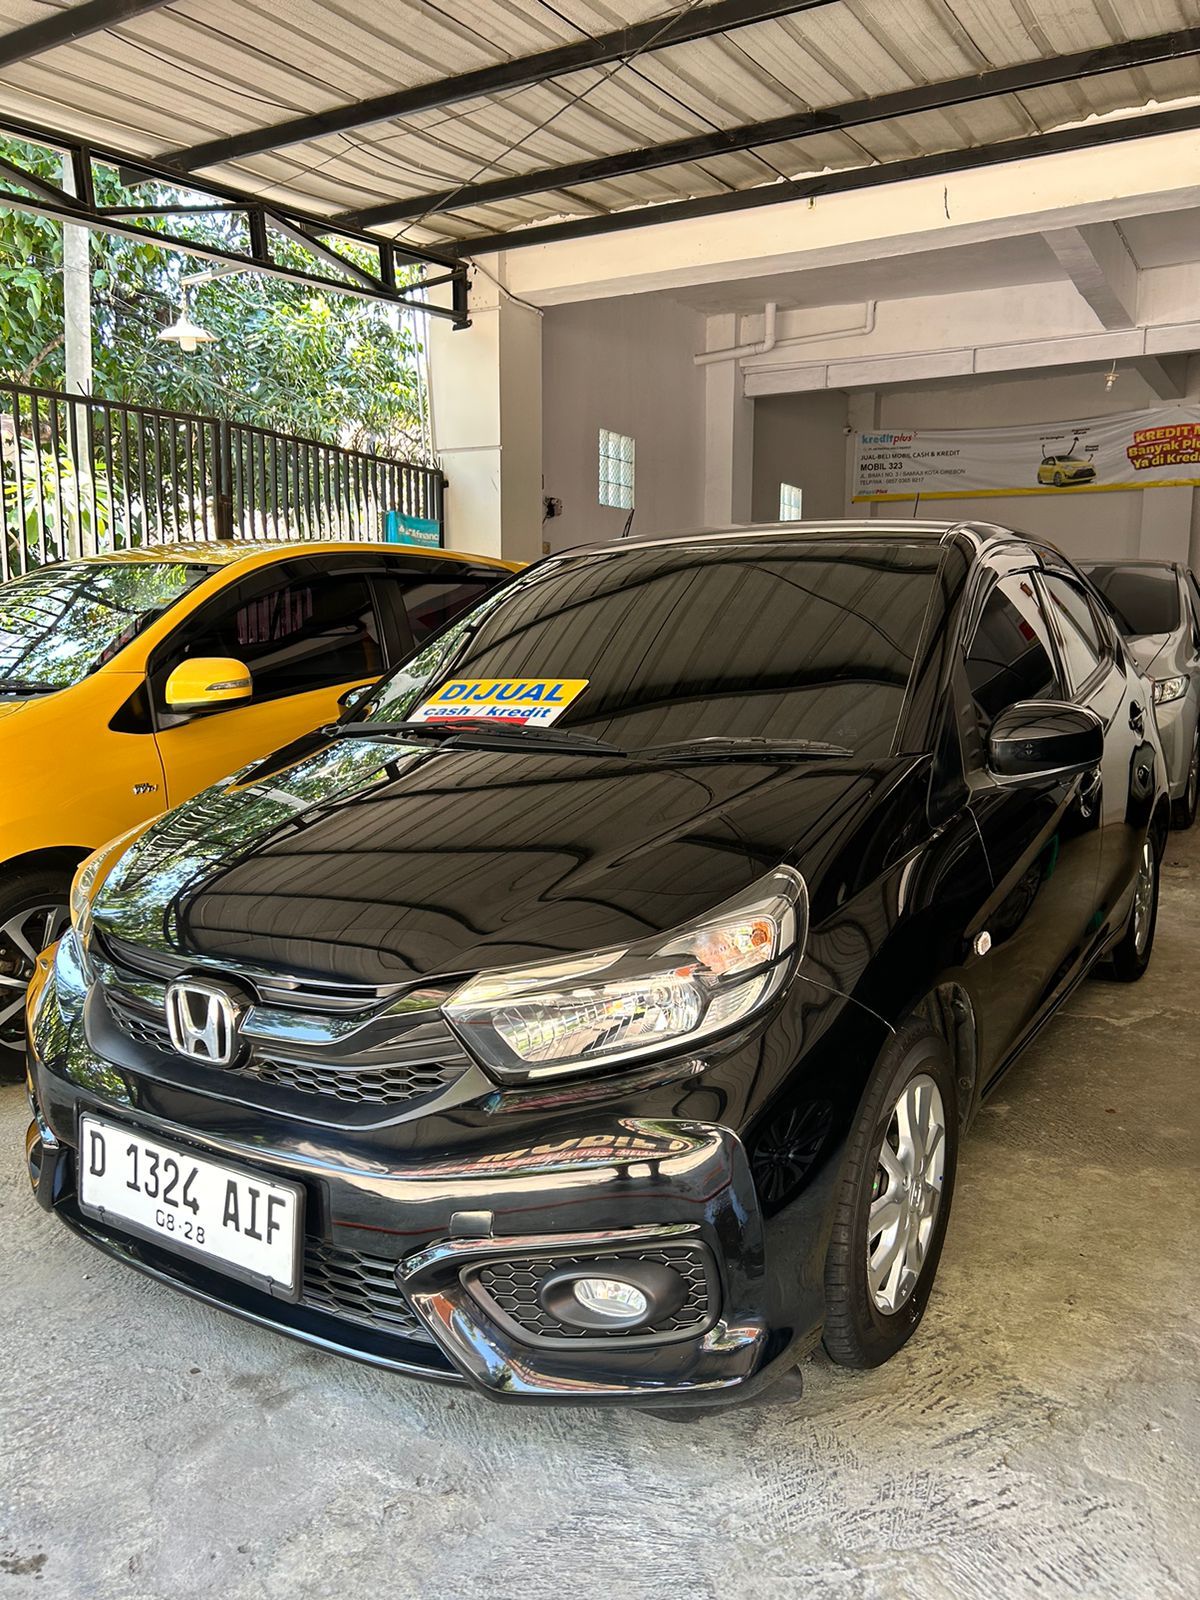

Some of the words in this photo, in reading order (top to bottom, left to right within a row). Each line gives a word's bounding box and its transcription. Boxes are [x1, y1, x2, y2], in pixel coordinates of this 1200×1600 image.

[862, 433, 912, 445] kreditplus
[1135, 426, 1191, 442] KREDIT
[936, 449, 960, 457] KREDIT
[1128, 440, 1179, 457] Banyak
[860, 463, 886, 471] MOBIL
[889, 462, 903, 470] 323
[1133, 458, 1149, 469] Ya
[1151, 454, 1164, 465] di
[1167, 451, 1200, 464] Kred
[439, 684, 563, 701] DIJUAL
[423, 706, 471, 716] cash
[486, 706, 552, 718] kredit
[90, 1130, 106, 1177] D
[126, 1143, 200, 1215] 1324
[222, 1179, 286, 1245] AIF
